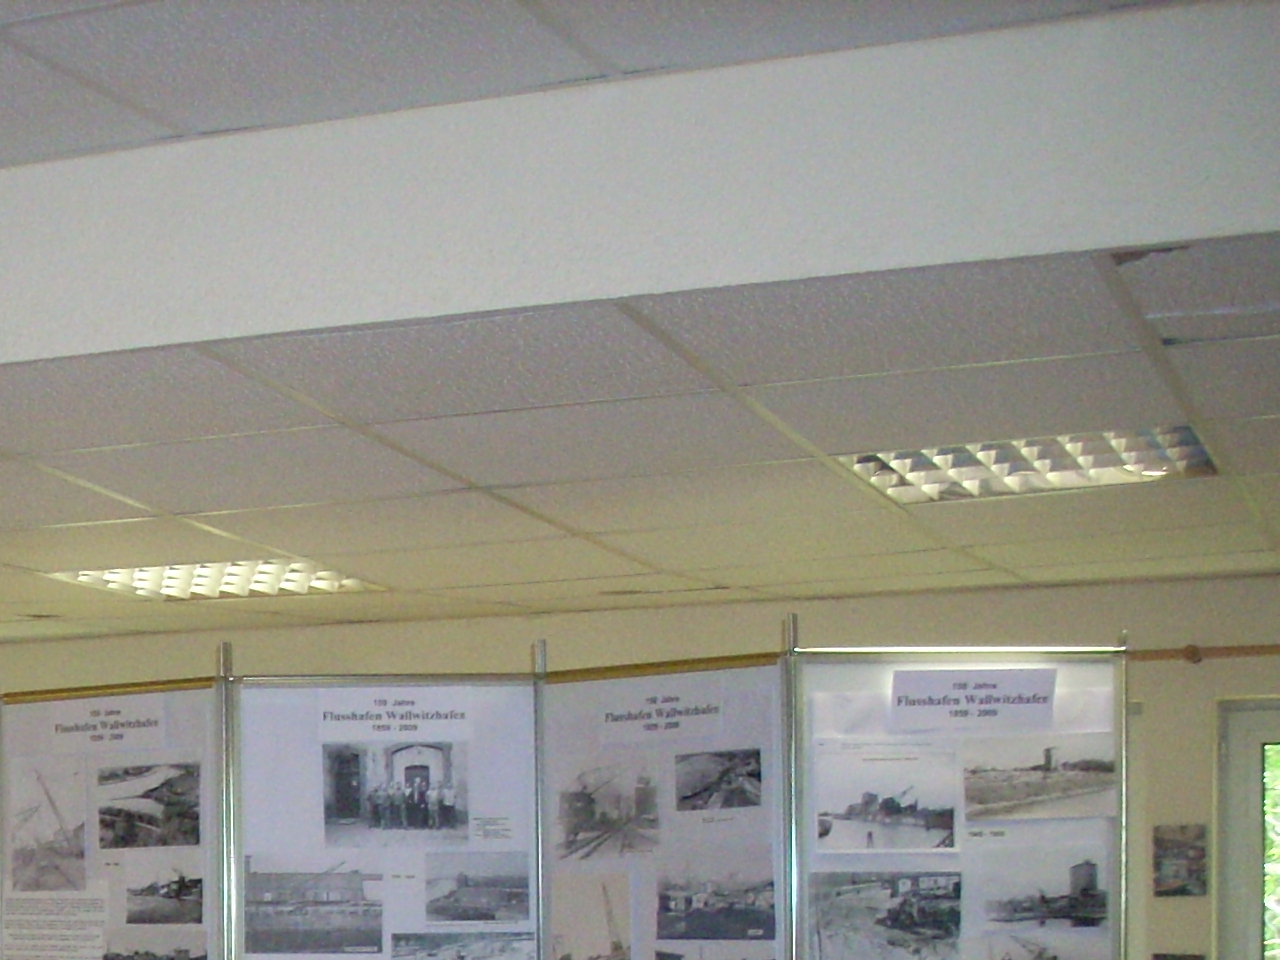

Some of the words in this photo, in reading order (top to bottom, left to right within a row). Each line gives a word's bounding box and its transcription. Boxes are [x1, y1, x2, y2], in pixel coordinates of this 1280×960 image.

[897, 695, 960, 706] Flusshafen
[965, 693, 1048, 704] Wallwitzhafen
[323, 711, 382, 721] Flusshafen
[386, 710, 466, 721] Wallwitzhafen
